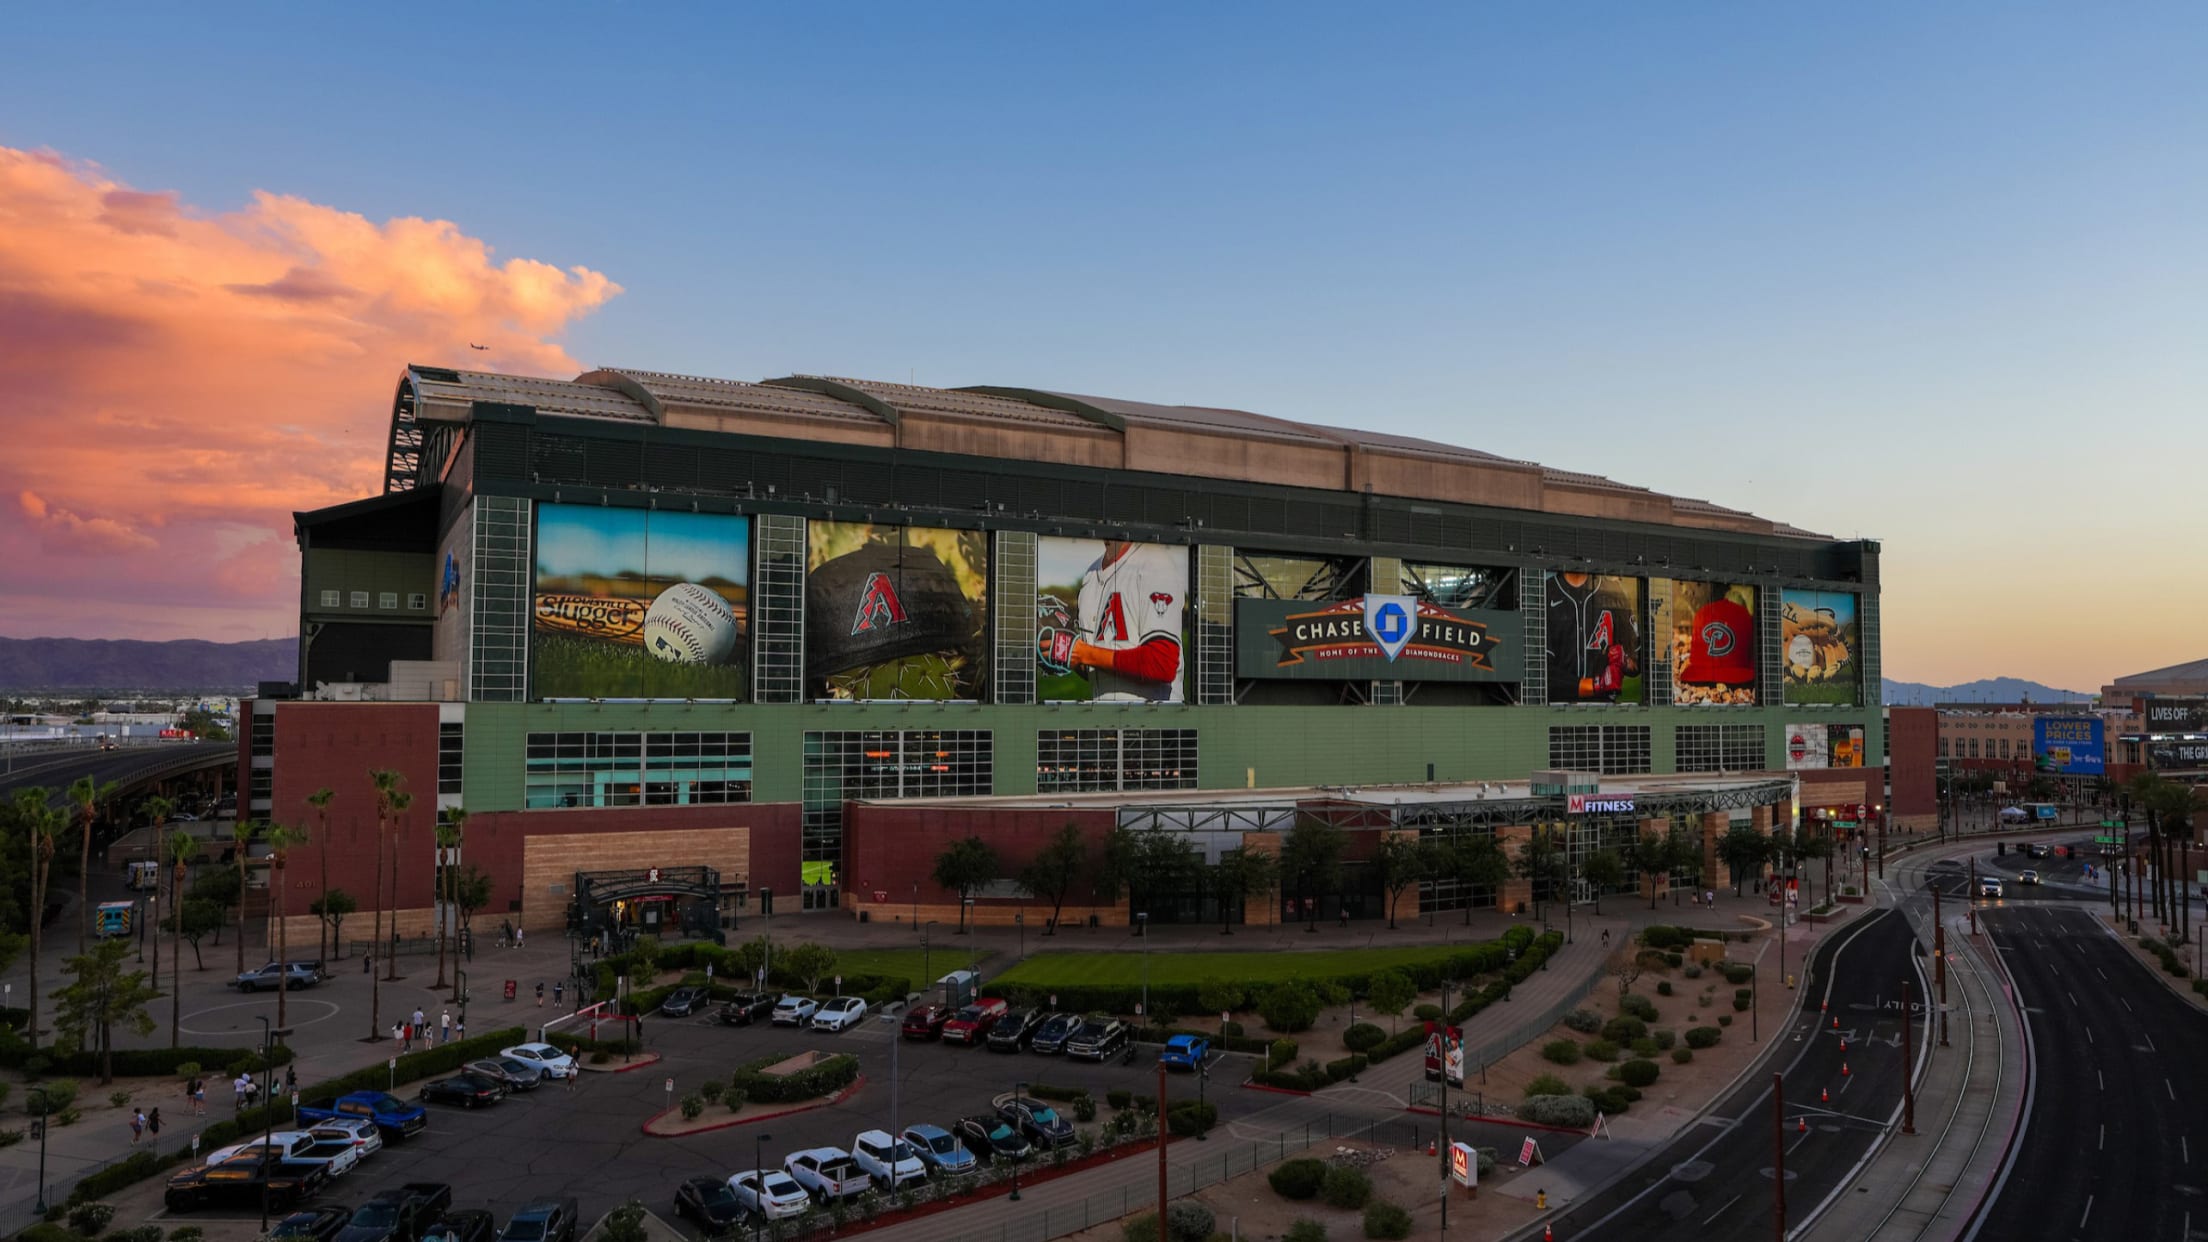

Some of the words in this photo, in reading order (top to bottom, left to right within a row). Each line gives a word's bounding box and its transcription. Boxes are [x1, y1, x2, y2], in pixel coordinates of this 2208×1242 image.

[564, 596, 630, 609] LOUISVILLE
[539, 596, 630, 629] Slugger
[1296, 621, 1361, 641] CHASE
[1422, 623, 1481, 646] FIELD
[1319, 649, 1342, 657] HOME
[1363, 647, 1378, 655] THE
[1405, 649, 1460, 662] DIAMONDBACKS
[2151, 707, 2172, 720] LIVES
[2173, 707, 2188, 720] OFF
[2045, 721, 2091, 731] LOWER
[2045, 731, 2091, 740] PRICES
[2179, 746, 2194, 760] THE
[1584, 800, 1634, 813] FITNESS
[1455, 1148, 1466, 1167] M
